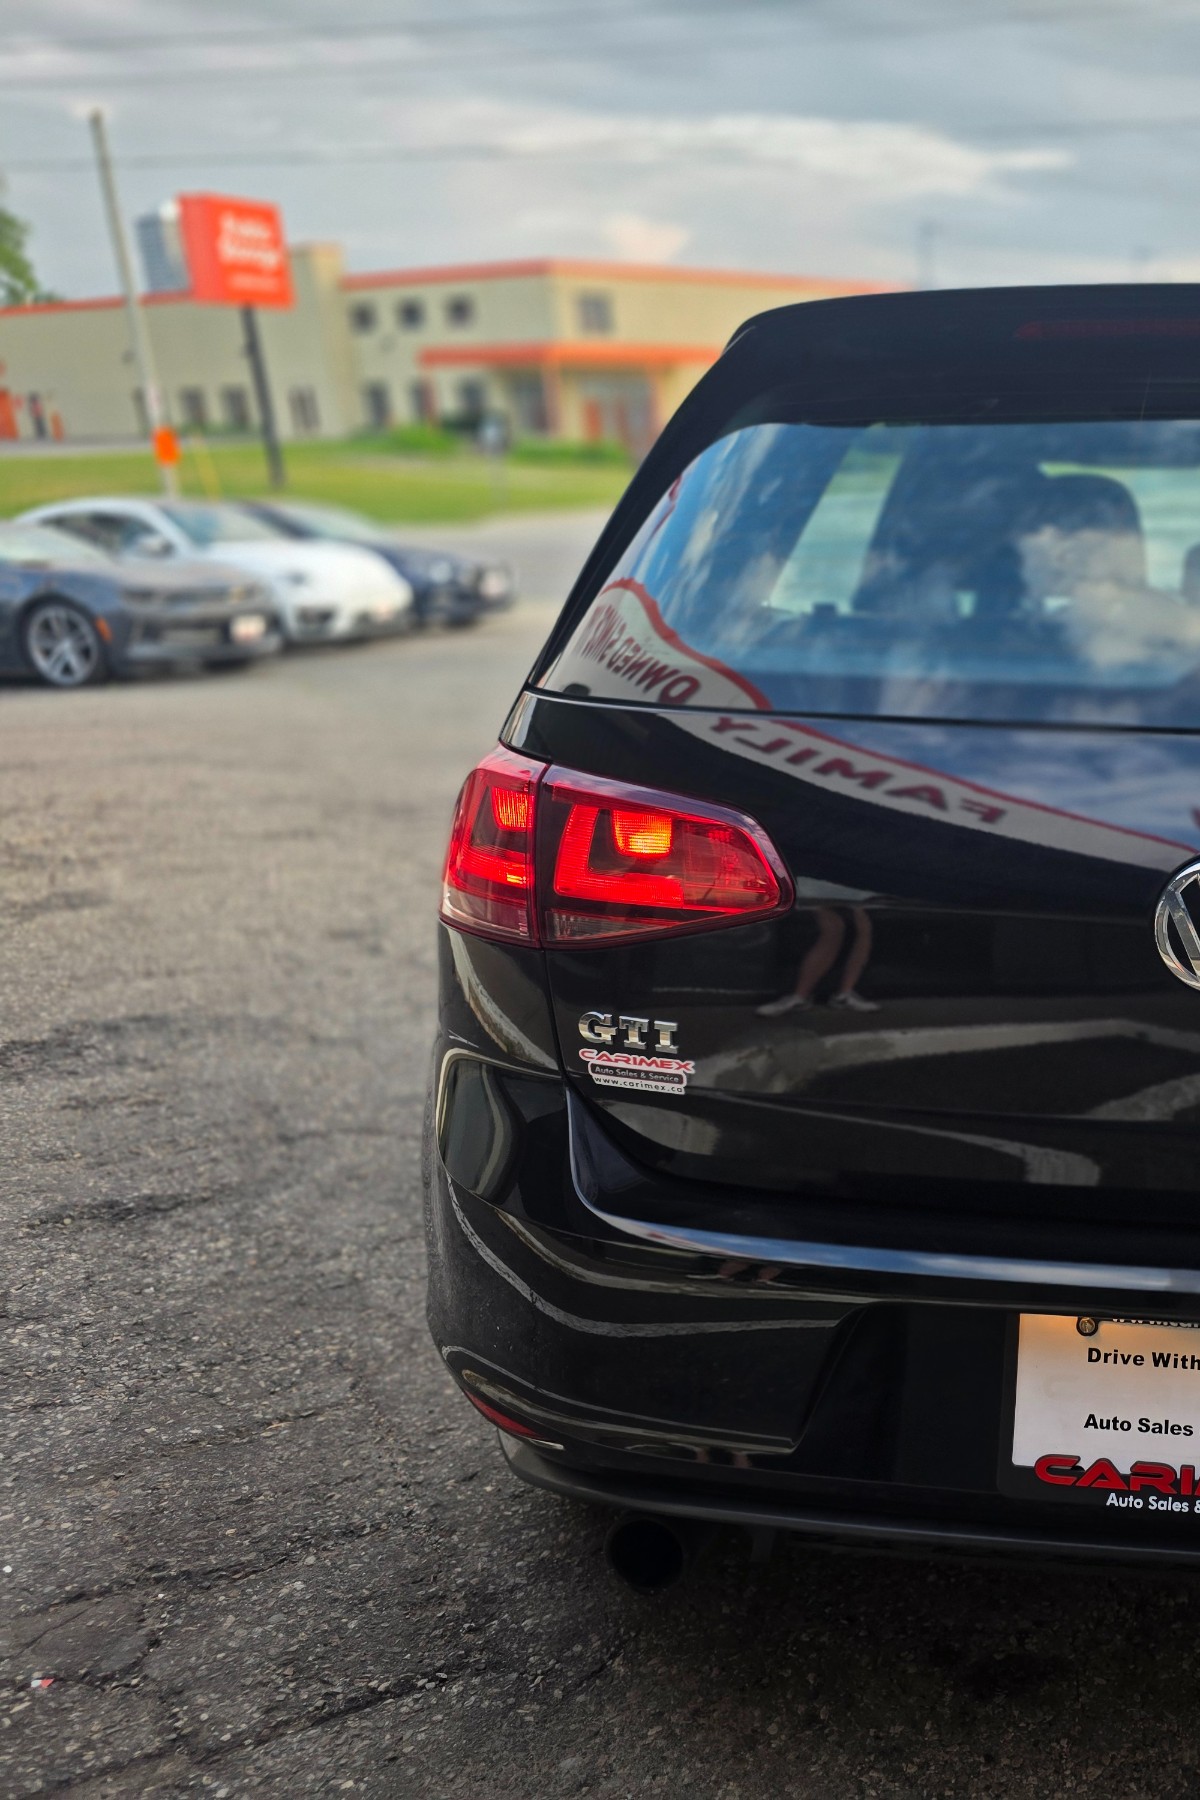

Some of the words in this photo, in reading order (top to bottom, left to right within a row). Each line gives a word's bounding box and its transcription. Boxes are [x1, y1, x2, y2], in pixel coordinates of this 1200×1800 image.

[578, 1011, 679, 1055] GTI
[579, 1049, 694, 1073] CARIMEX
[594, 1077, 683, 1093] www.carimex.ca
[595, 1066, 614, 1075] Auto
[616, 1069, 638, 1078] Sales
[649, 1073, 679, 1083] Service
[1087, 1347, 1145, 1367] Drive
[1084, 1413, 1132, 1433] Auto
[1137, 1417, 1194, 1437] Sales
[1106, 1492, 1144, 1510] Auto
[1148, 1496, 1189, 1513] Sales
